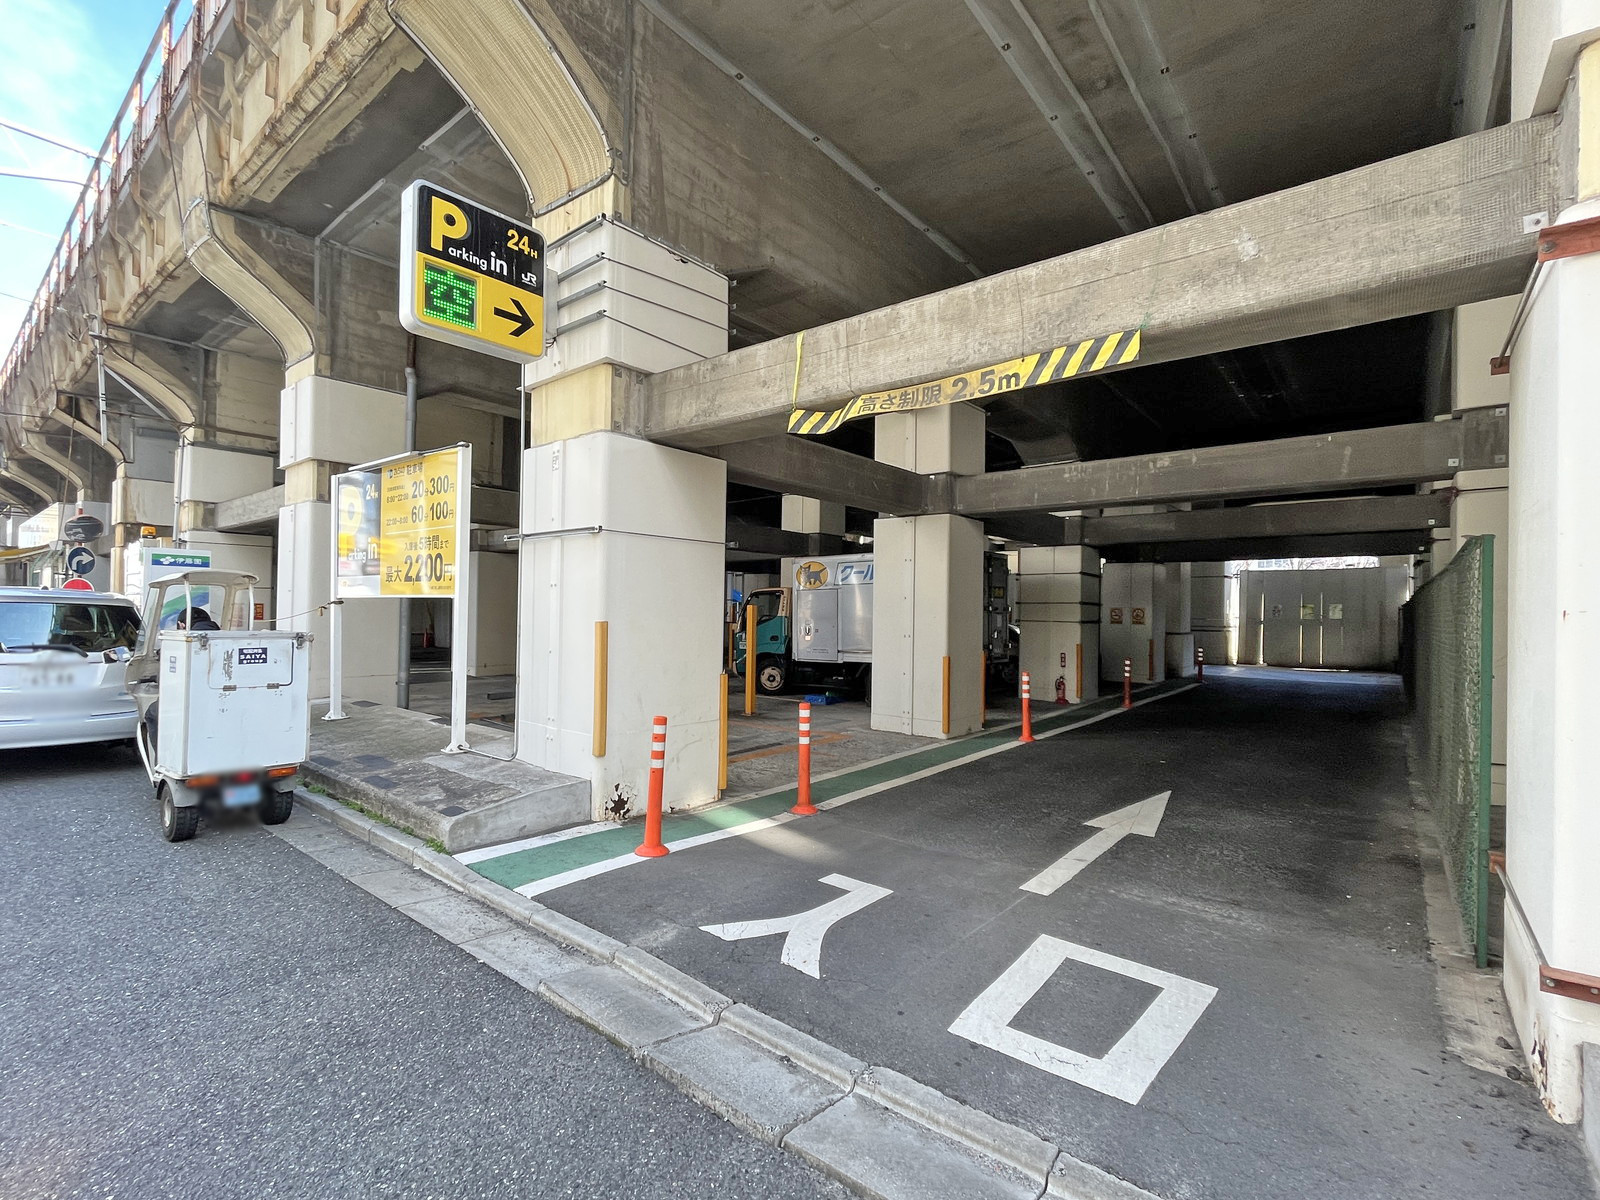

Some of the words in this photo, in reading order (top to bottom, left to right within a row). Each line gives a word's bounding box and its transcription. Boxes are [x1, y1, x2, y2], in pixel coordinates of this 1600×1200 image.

[506, 229, 538, 259] 24H
[490, 251, 508, 276] in
[521, 272, 537, 284] JR
[423, 269, 476, 330] 空
[857, 382, 942, 415] 高さ制限
[951, 368, 1021, 400] 2.5m
[367, 537, 378, 560] in
